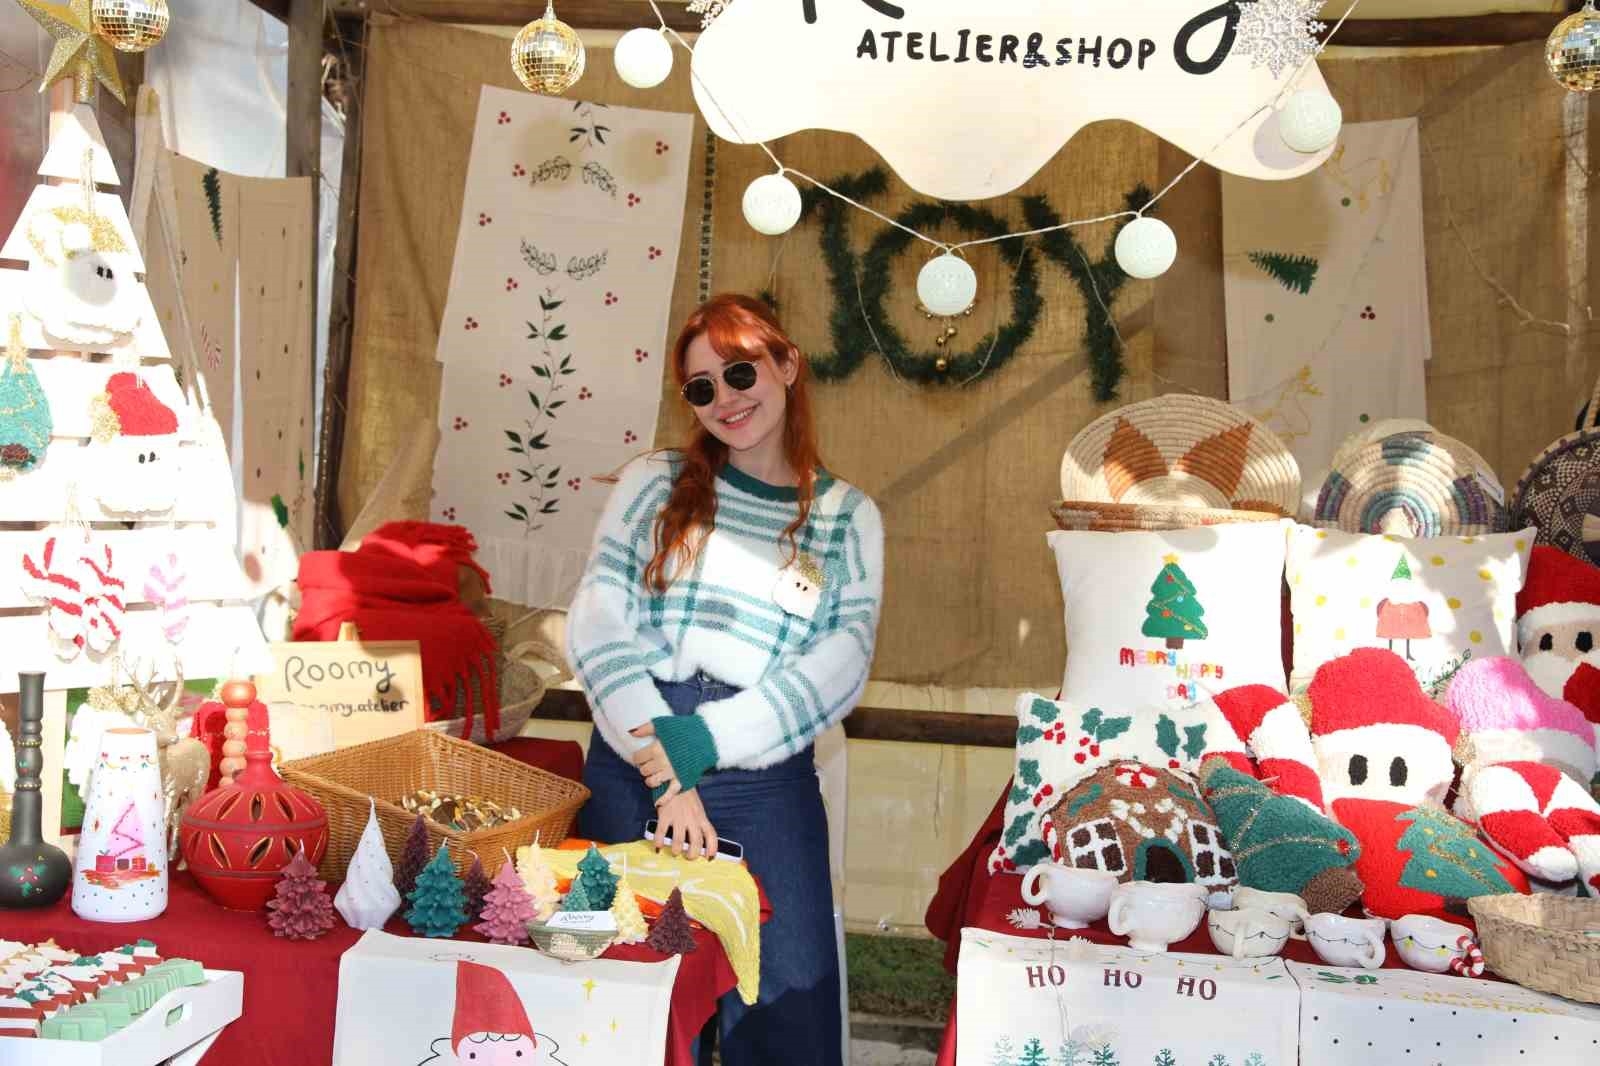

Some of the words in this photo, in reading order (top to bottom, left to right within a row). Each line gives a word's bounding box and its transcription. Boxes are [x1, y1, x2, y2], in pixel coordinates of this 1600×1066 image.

[1119, 647, 1177, 666] MERRY
[285, 655, 396, 694] Roomy
[1166, 681, 1197, 701] DAY
[1025, 964, 1067, 989] HO
[1103, 967, 1143, 990] HO
[1176, 975, 1217, 1001] HO
